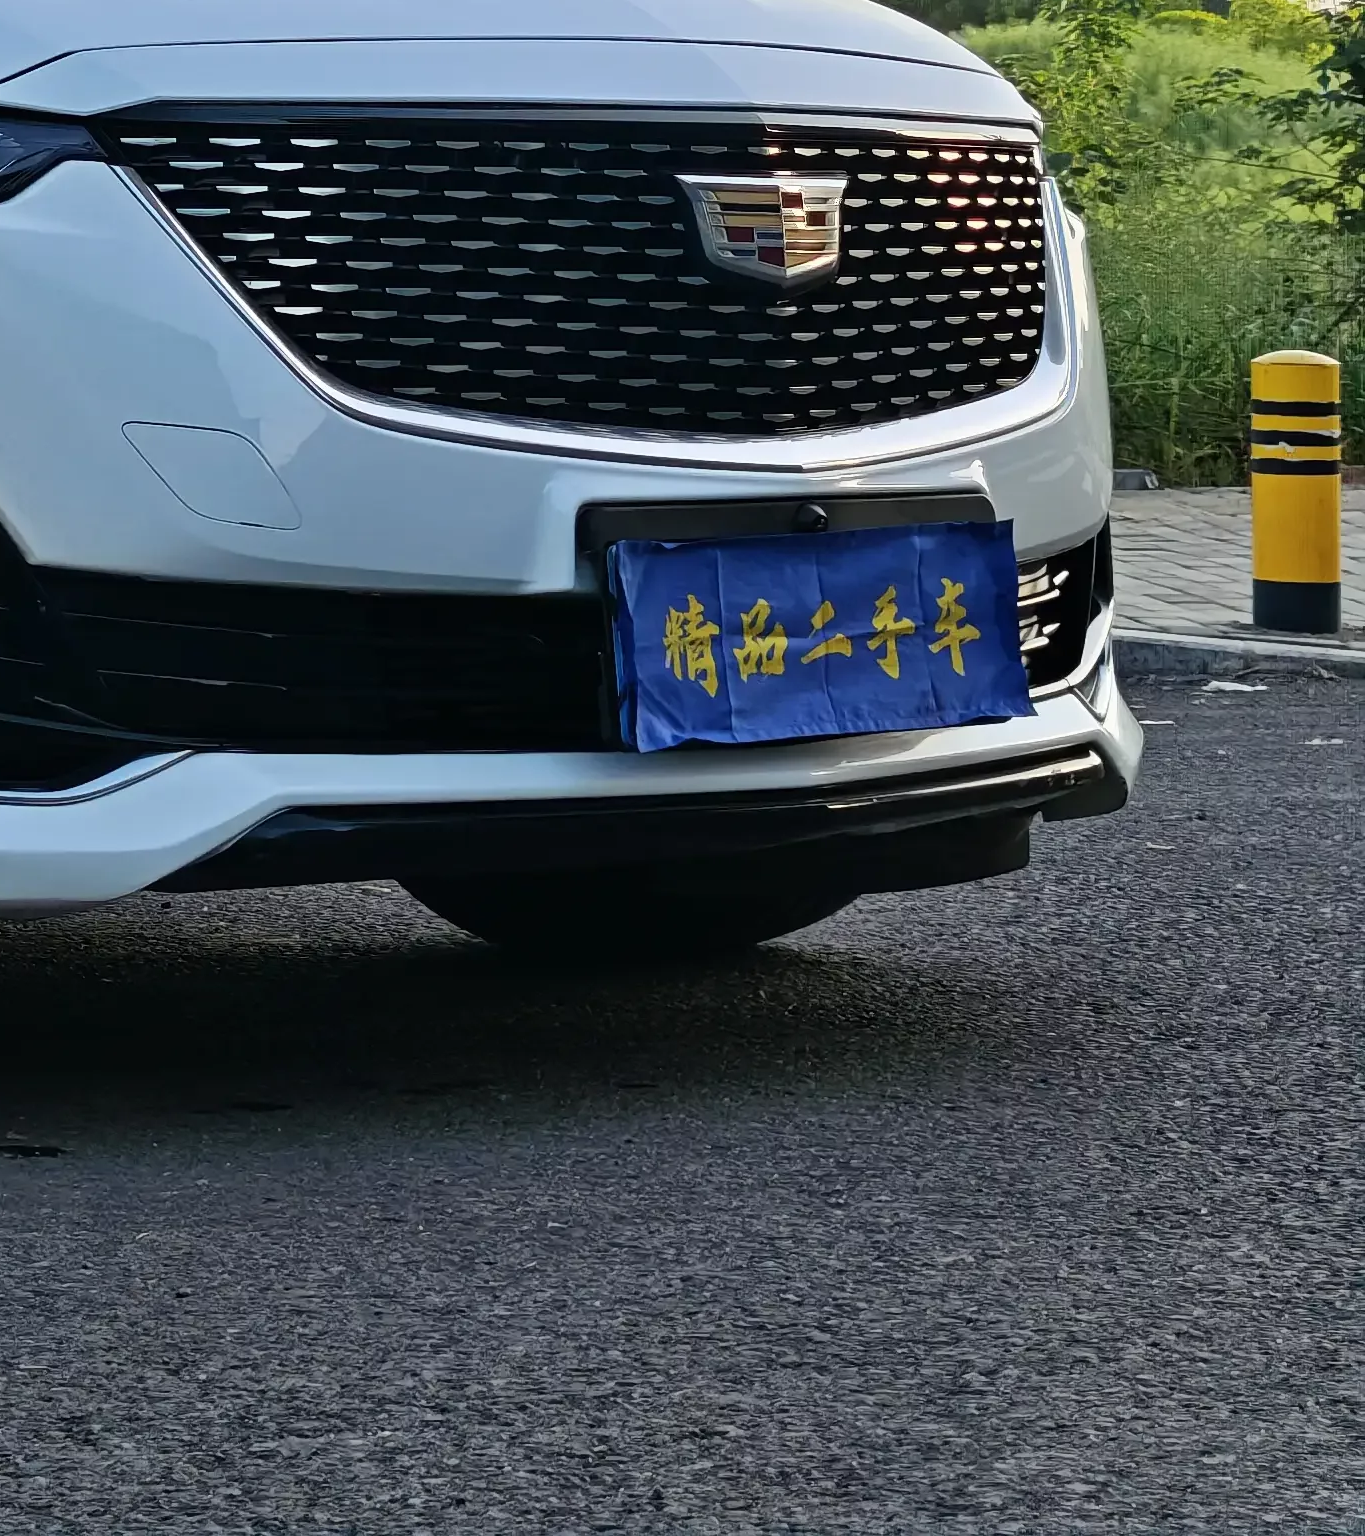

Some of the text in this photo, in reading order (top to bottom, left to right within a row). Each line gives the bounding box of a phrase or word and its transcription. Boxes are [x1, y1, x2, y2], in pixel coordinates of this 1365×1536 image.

[663, 577, 981, 698] 精品二手车
